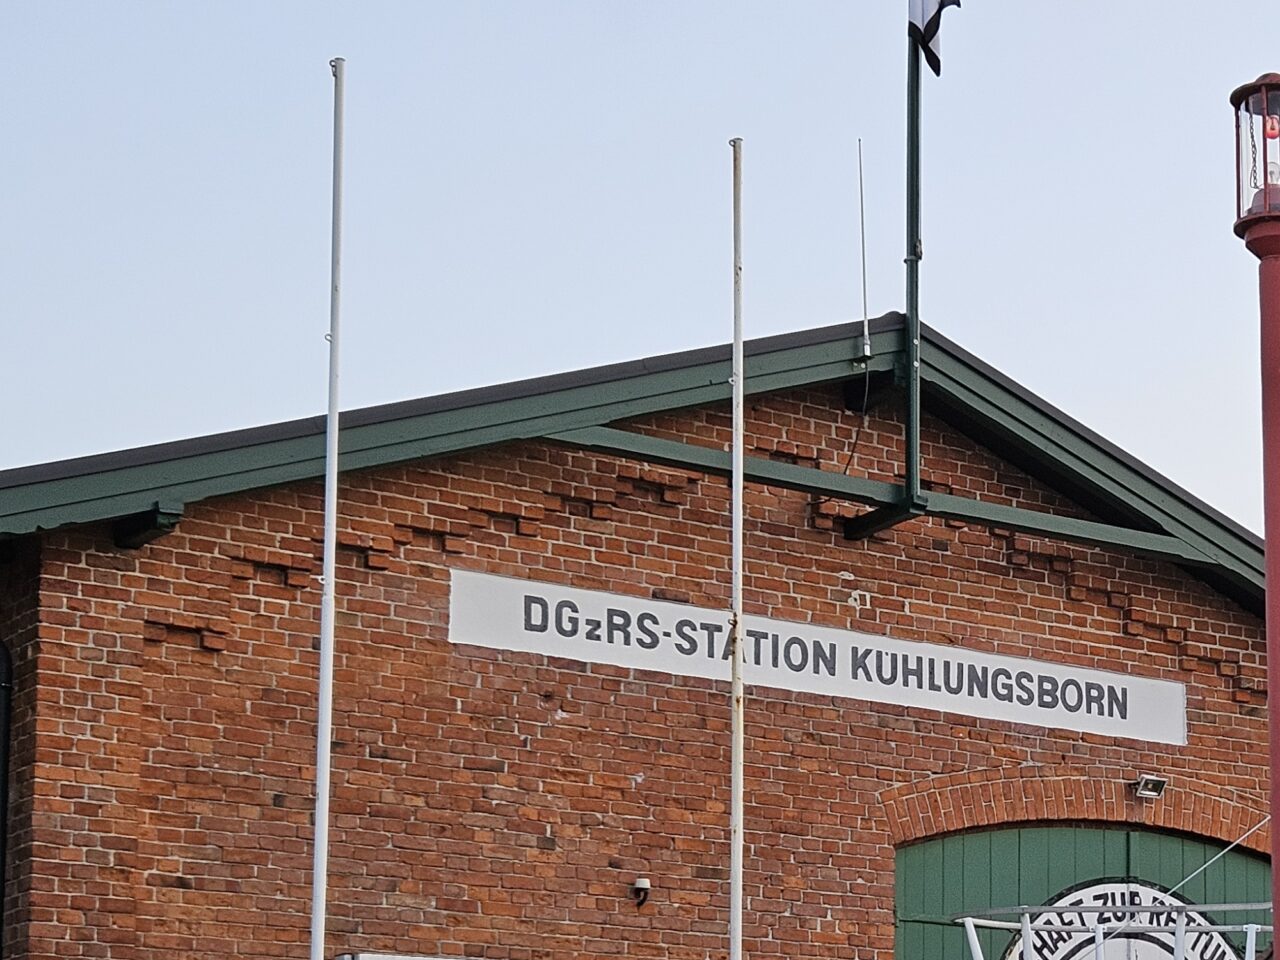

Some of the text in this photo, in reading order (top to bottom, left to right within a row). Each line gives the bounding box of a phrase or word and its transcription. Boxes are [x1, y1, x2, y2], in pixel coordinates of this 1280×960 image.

[524, 594, 1129, 721] DGzRS-STATION KÜHLUNGSBORN
[1092, 890, 1142, 925] ZUR
